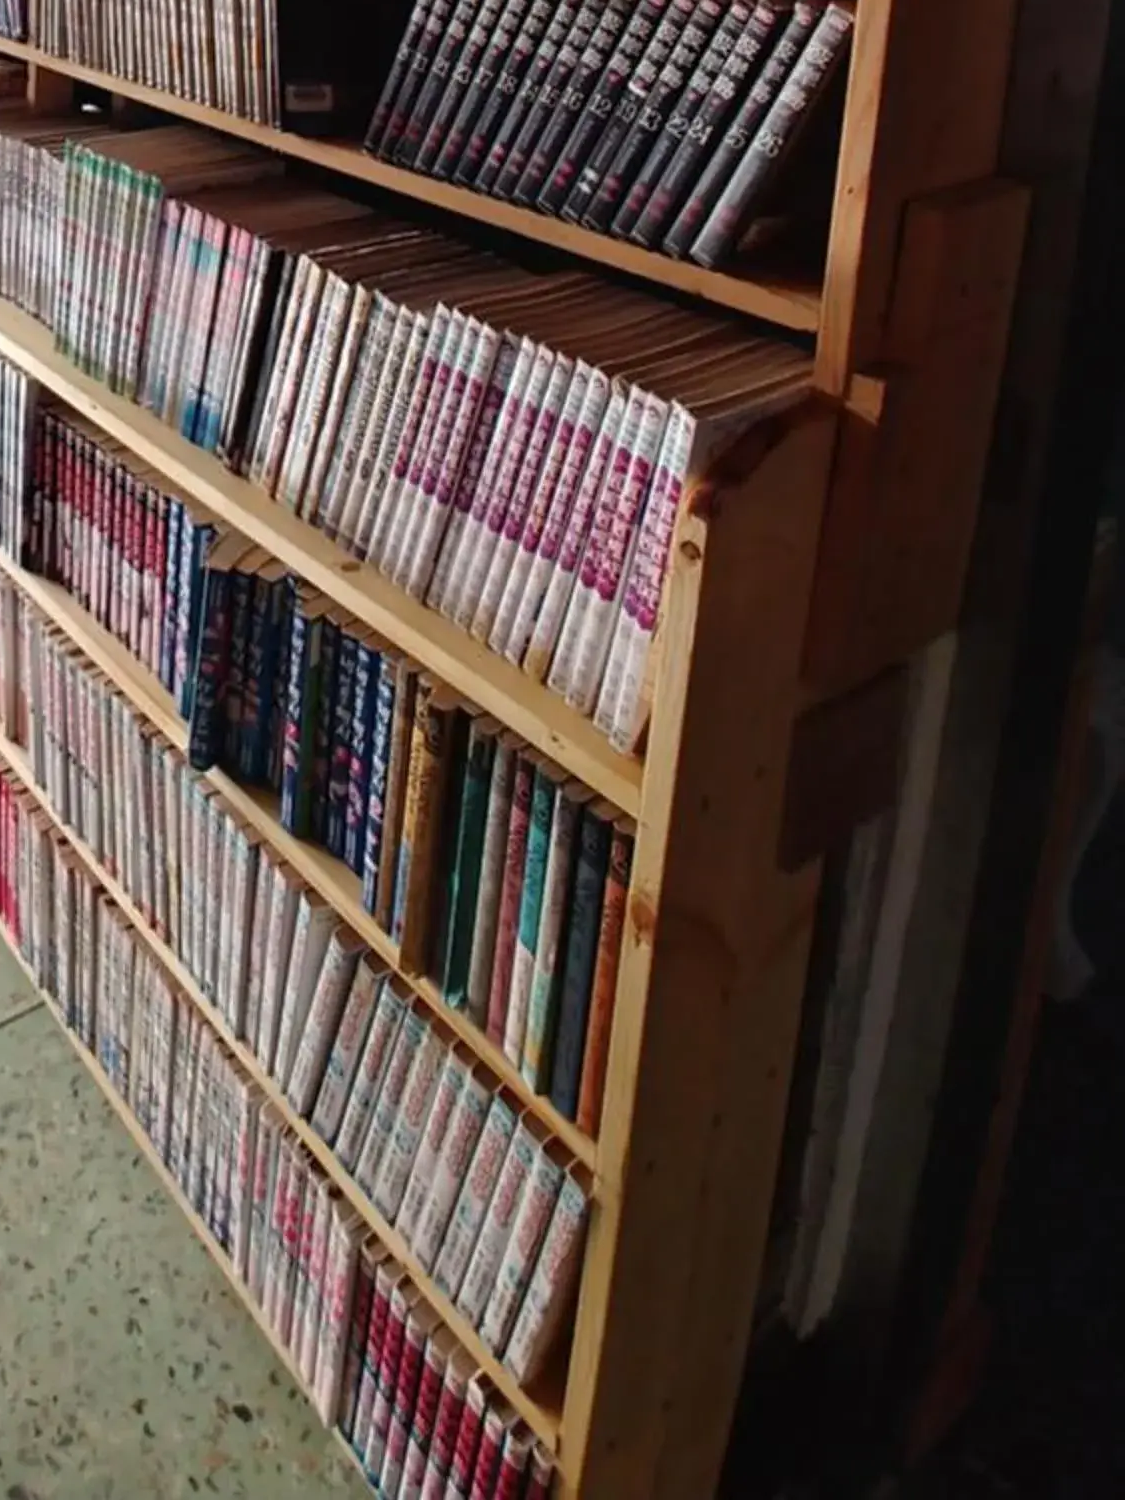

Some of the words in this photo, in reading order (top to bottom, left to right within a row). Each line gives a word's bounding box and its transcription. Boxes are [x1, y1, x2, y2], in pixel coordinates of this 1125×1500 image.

[589, 93, 614, 119] 12
[638, 106, 662, 133] 13
[664, 113, 690, 141] 22
[758, 129, 785, 160] 26
